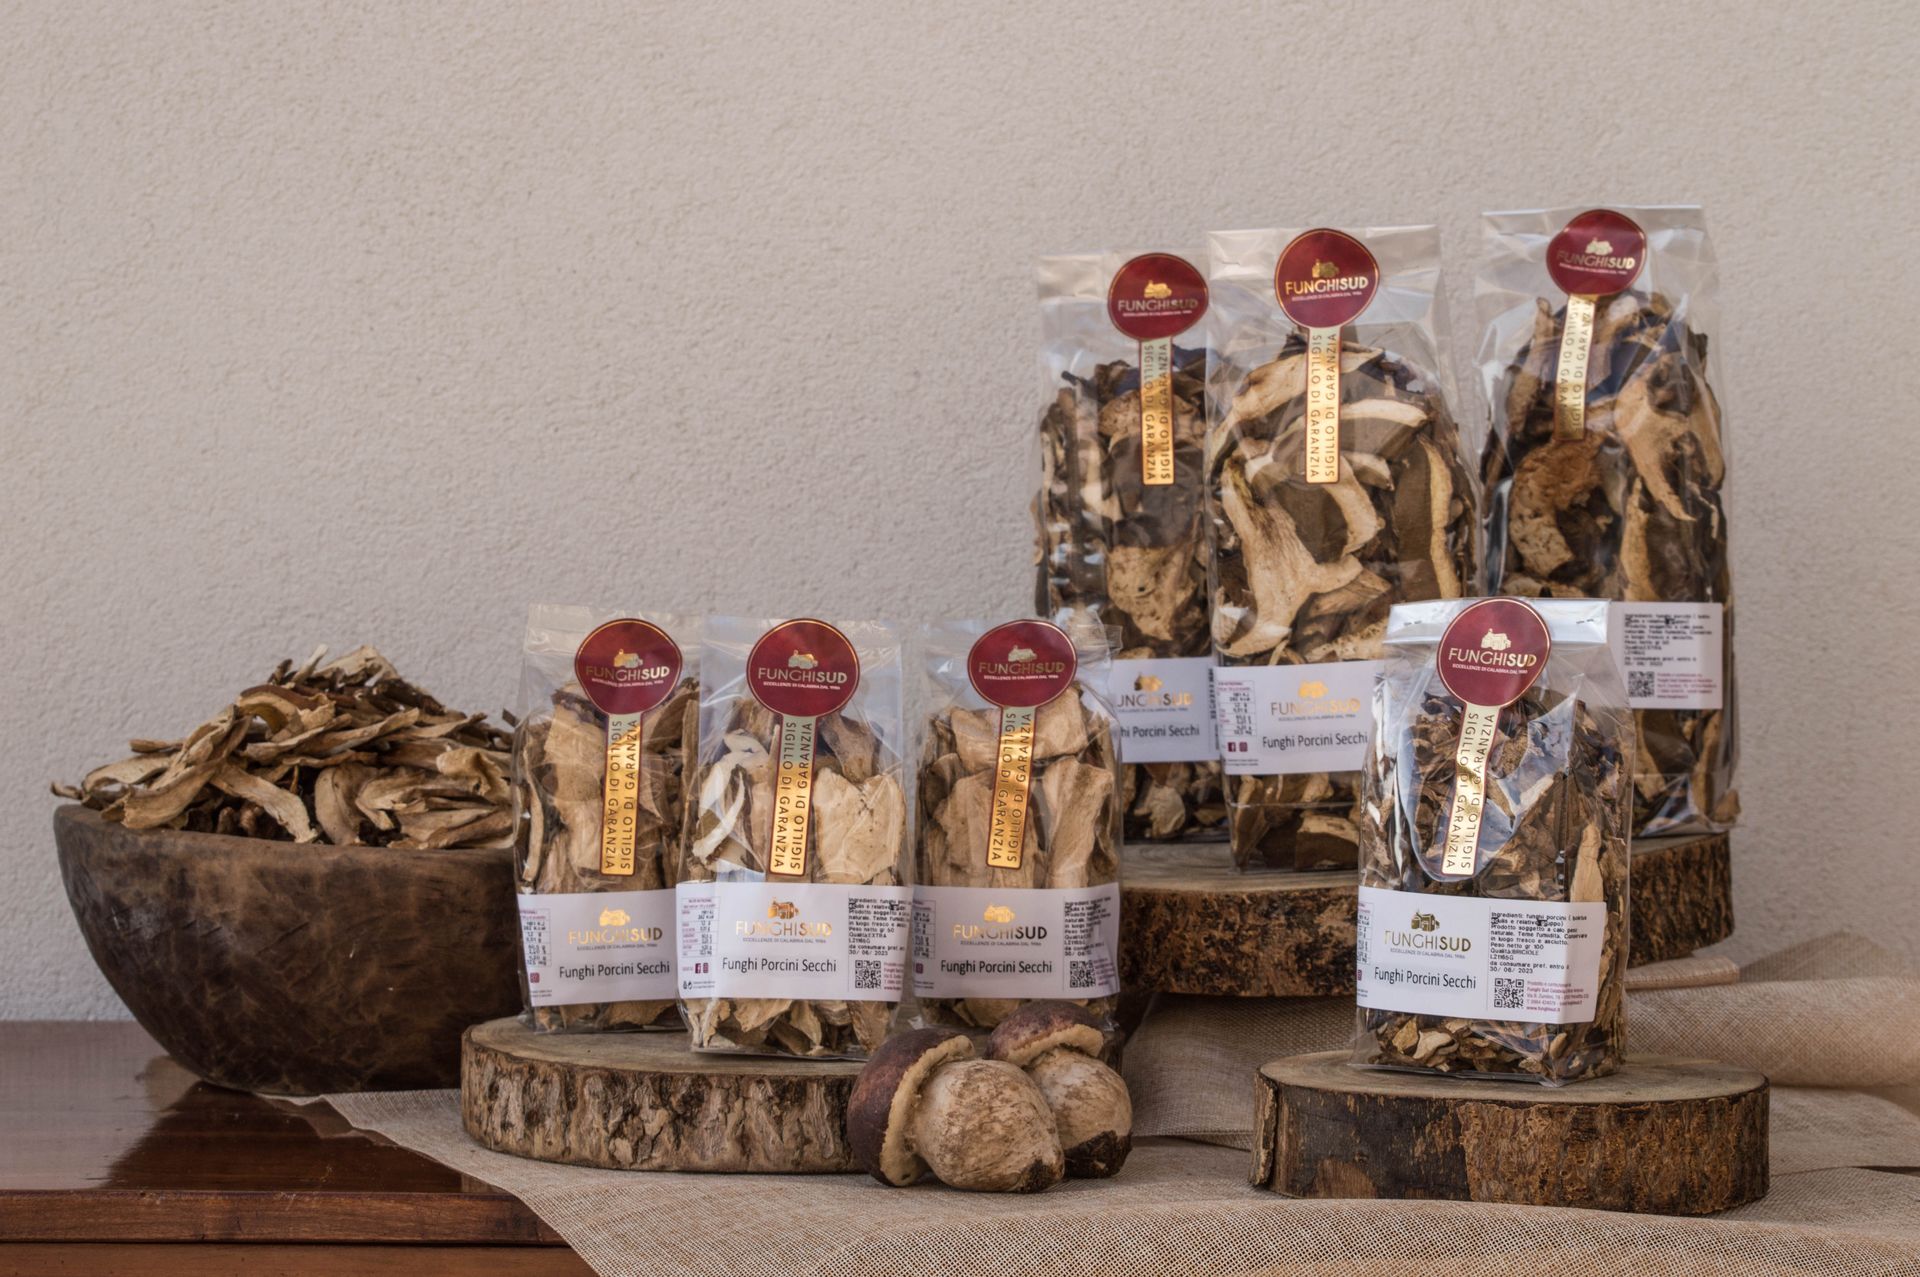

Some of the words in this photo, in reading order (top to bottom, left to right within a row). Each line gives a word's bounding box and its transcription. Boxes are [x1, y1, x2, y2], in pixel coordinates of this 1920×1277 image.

[1285, 276, 1369, 295] FUNGHISUD
[1118, 299, 1198, 311] FUNGHISUD
[1311, 334, 1322, 385] SIGILLO
[1325, 333, 1337, 401] GARANZIA
[1311, 390, 1320, 404] DI
[1325, 406, 1335, 420] DI
[1145, 413, 1157, 480] GARANZIA
[1310, 409, 1321, 478] GARANZIA
[1324, 425, 1335, 477] SIGILLO
[1159, 430, 1171, 480] SIGILLO
[979, 662, 1066, 674] FUNGHISUD
[1448, 647, 1537, 668] FUNGHISUD
[586, 666, 670, 681] FUNGHISUD
[758, 667, 848, 684] FUNGHISUD
[1002, 713, 1016, 763] SIGILLO
[1133, 726, 1166, 737] Porcini
[1169, 724, 1200, 736] Secchi
[1262, 736, 1295, 751] Funghi
[1298, 734, 1333, 747] Porcini
[1336, 732, 1368, 745] Secchi
[1459, 713, 1479, 766] SIGILLO
[610, 721, 622, 772] SIGILLO
[624, 720, 637, 790] GARANZIA
[782, 722, 796, 770] SIGILLO
[797, 722, 812, 789] GARANZIA
[1015, 713, 1032, 782] GARANZIA
[1473, 714, 1495, 785] GARANZIA
[609, 778, 620, 792] DI
[781, 776, 792, 790] DI
[1001, 769, 1011, 783] DI
[1460, 774, 1468, 788] DI
[624, 796, 634, 810] DI
[795, 795, 806, 809] DI
[1014, 789, 1025, 803] DI
[1471, 791, 1481, 806] DI
[605, 798, 618, 869] GARANZIA
[774, 796, 790, 868] GARANZIA
[992, 789, 1008, 860] GARANZIA
[1007, 809, 1022, 862] SIGILLO
[1446, 794, 1467, 868] GARANZIA
[621, 817, 633, 869] SIGILLO
[790, 815, 804, 869] SIGILLO
[1461, 813, 1478, 869] SIGILLO
[568, 927, 663, 944] FUNGHISUD
[735, 920, 833, 937] FUNGHISUD
[953, 923, 1048, 940] FUNGHISUD
[1384, 930, 1472, 953] FUNGHISUD
[559, 965, 595, 981] Funghi
[598, 962, 634, 976] Porcini
[636, 961, 670, 975] Secchi
[722, 957, 758, 974] Funghi
[761, 958, 799, 972] Porcini
[802, 958, 837, 973] Secchi
[940, 959, 976, 976] Funghi
[979, 960, 1016, 974] Porcini
[1018, 960, 1053, 974] Secchi
[1374, 966, 1404, 984] Funghi
[1406, 970, 1440, 986] Porcini
[1442, 973, 1476, 989] Secchi
